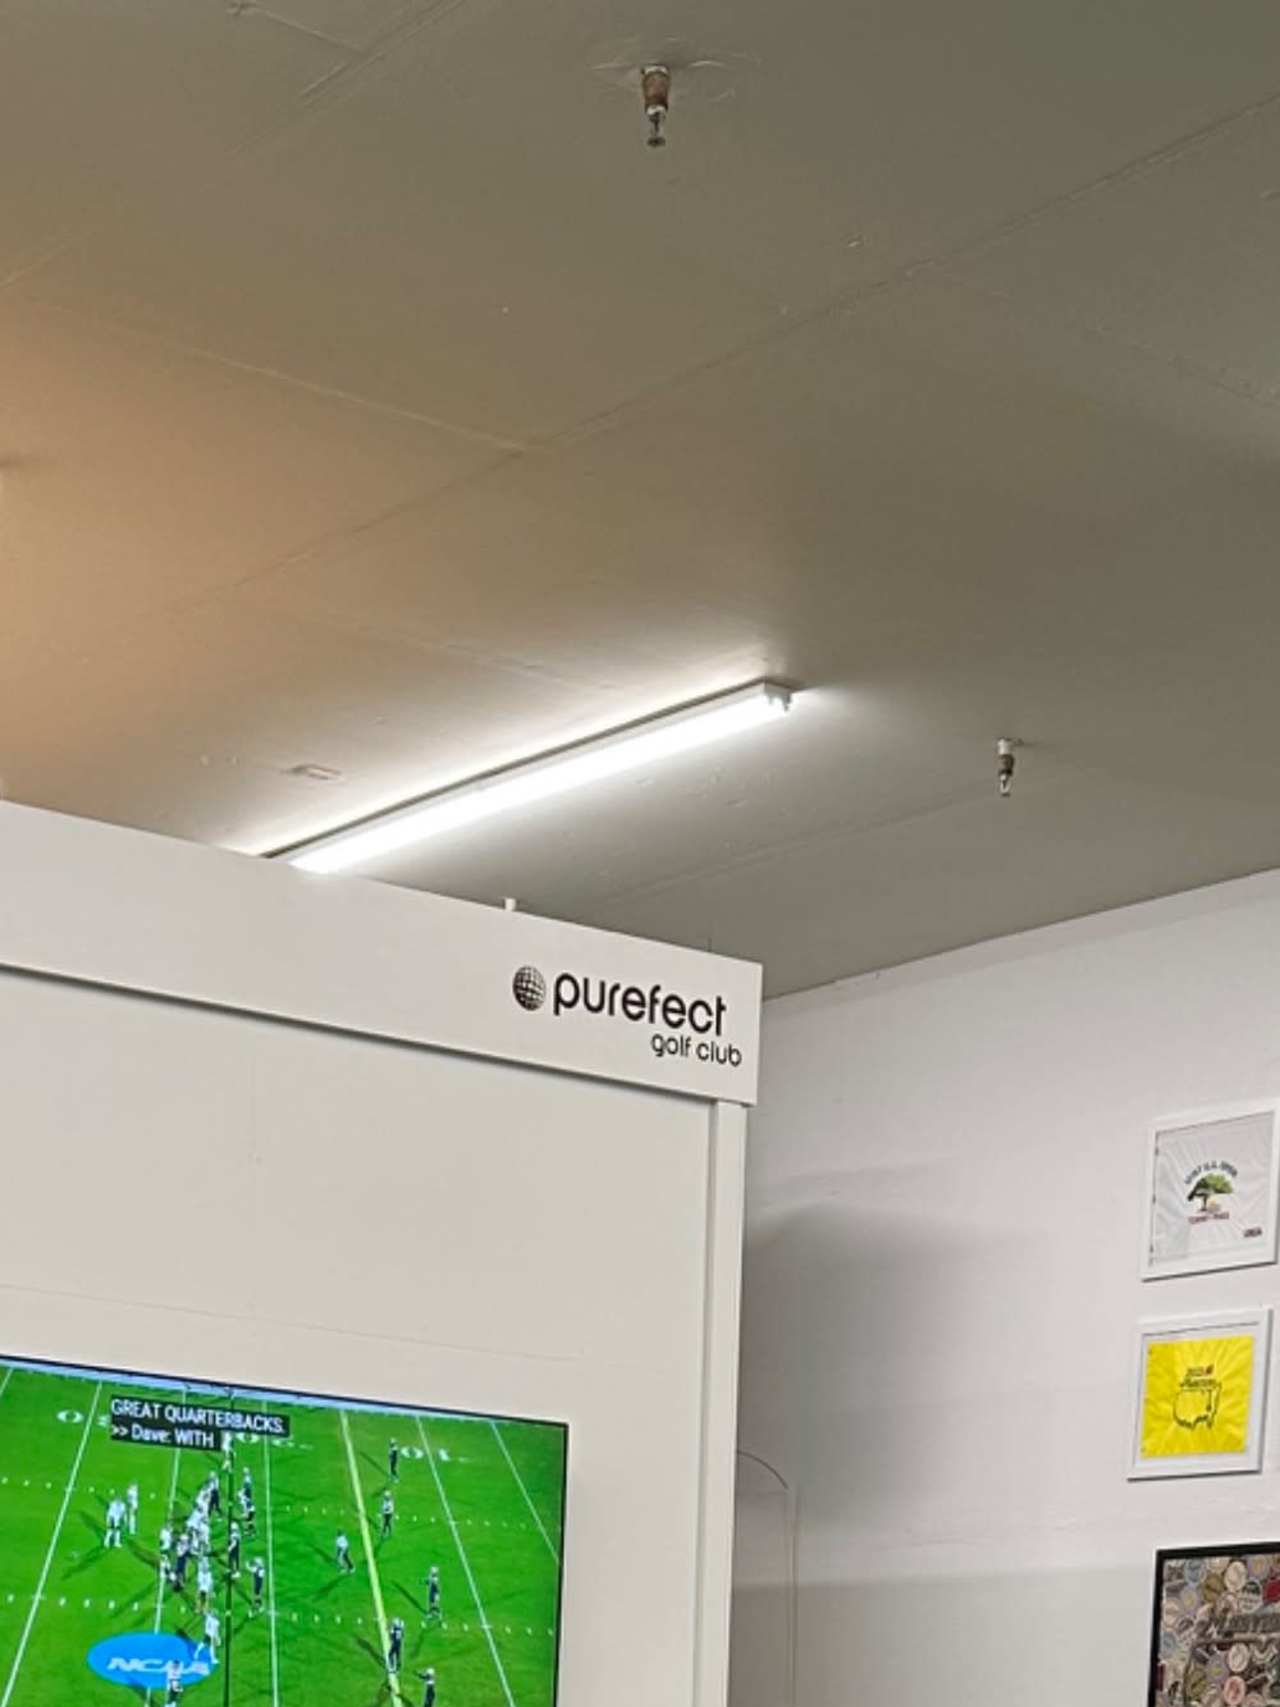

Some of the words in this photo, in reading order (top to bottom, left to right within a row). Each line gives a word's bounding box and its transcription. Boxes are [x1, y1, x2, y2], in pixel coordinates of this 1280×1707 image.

[553, 973, 727, 1036] purefect
[651, 1033, 692, 1058] golf
[696, 1040, 743, 1067] club
[111, 1398, 160, 1420] GREAT
[164, 1404, 284, 1433] QUARTERBACKS.
[131, 1424, 171, 1443] Dave:
[174, 1427, 215, 1449] WITH
